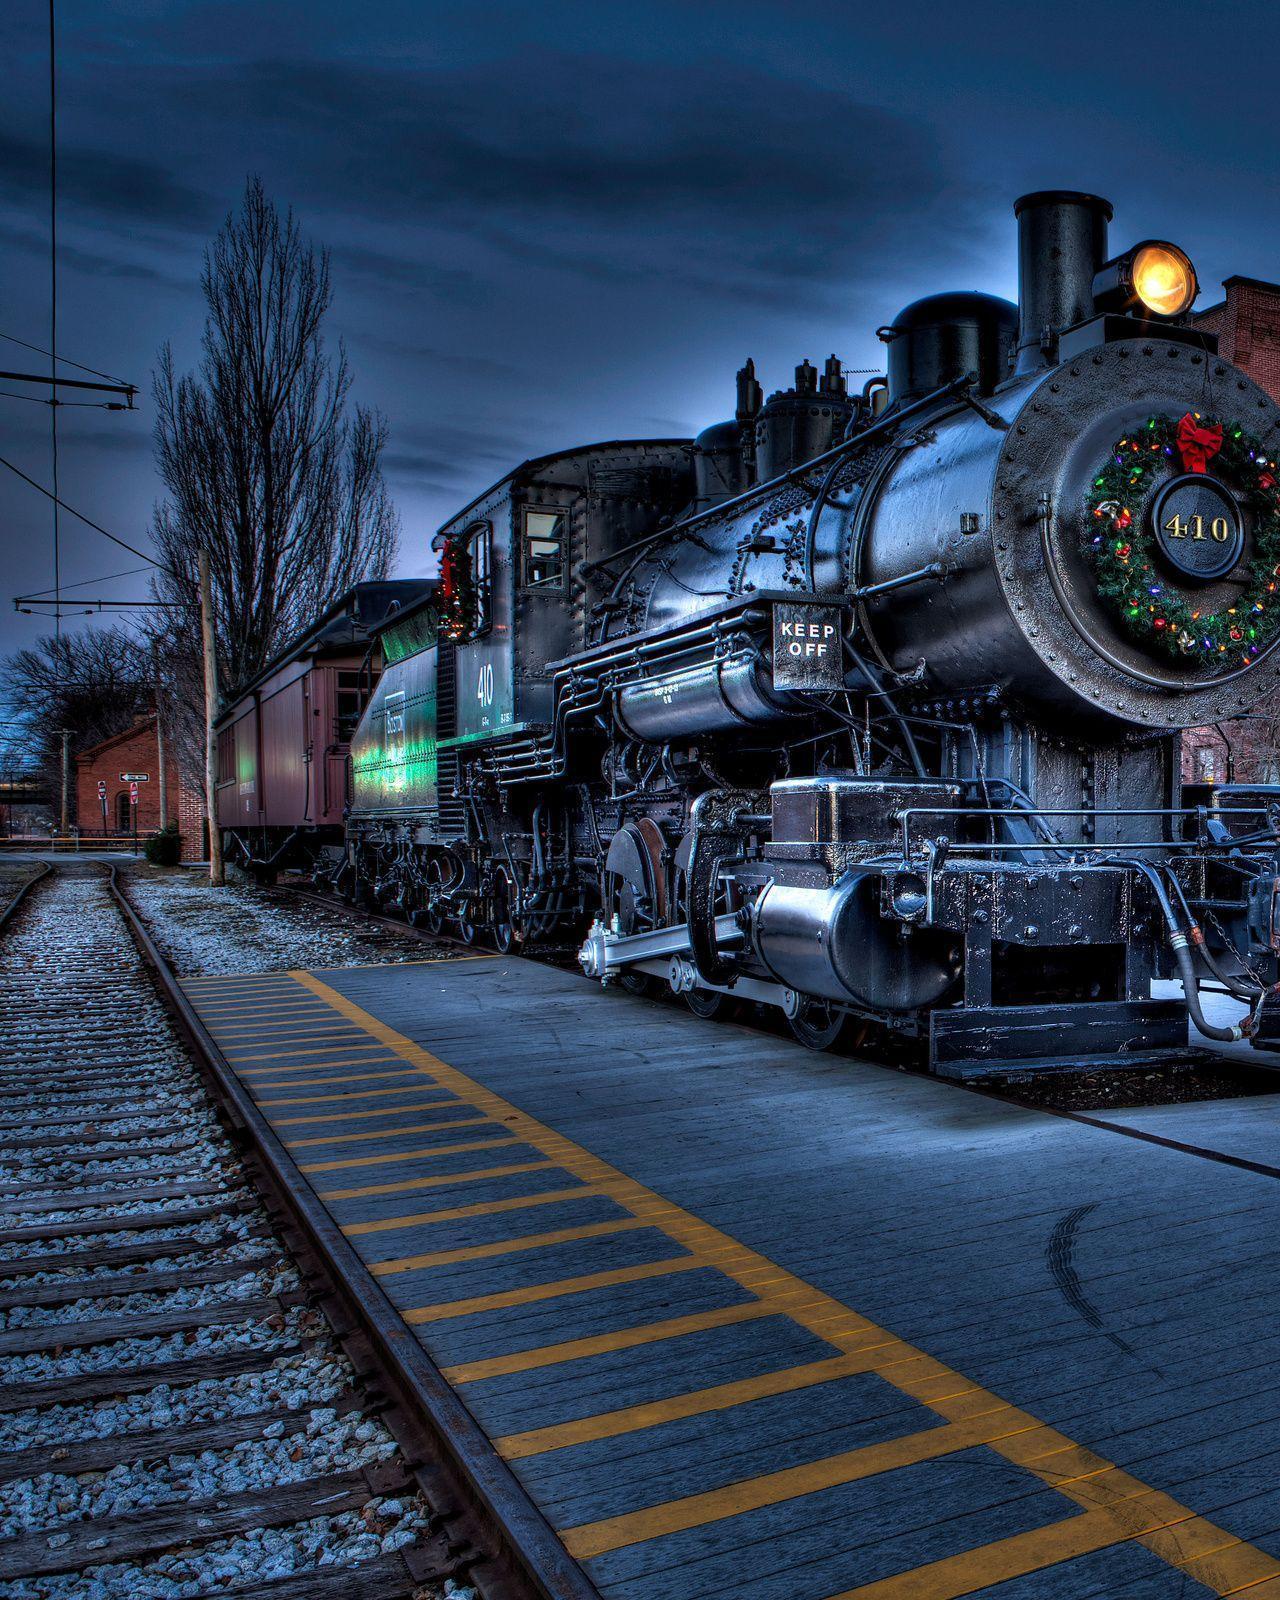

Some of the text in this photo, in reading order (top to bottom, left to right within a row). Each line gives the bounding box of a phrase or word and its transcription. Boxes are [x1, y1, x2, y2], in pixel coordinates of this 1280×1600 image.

[1165, 514, 1229, 542] 410
[781, 622, 834, 638] KEEP
[789, 642, 827, 657] OFF
[477, 663, 494, 707] 410
